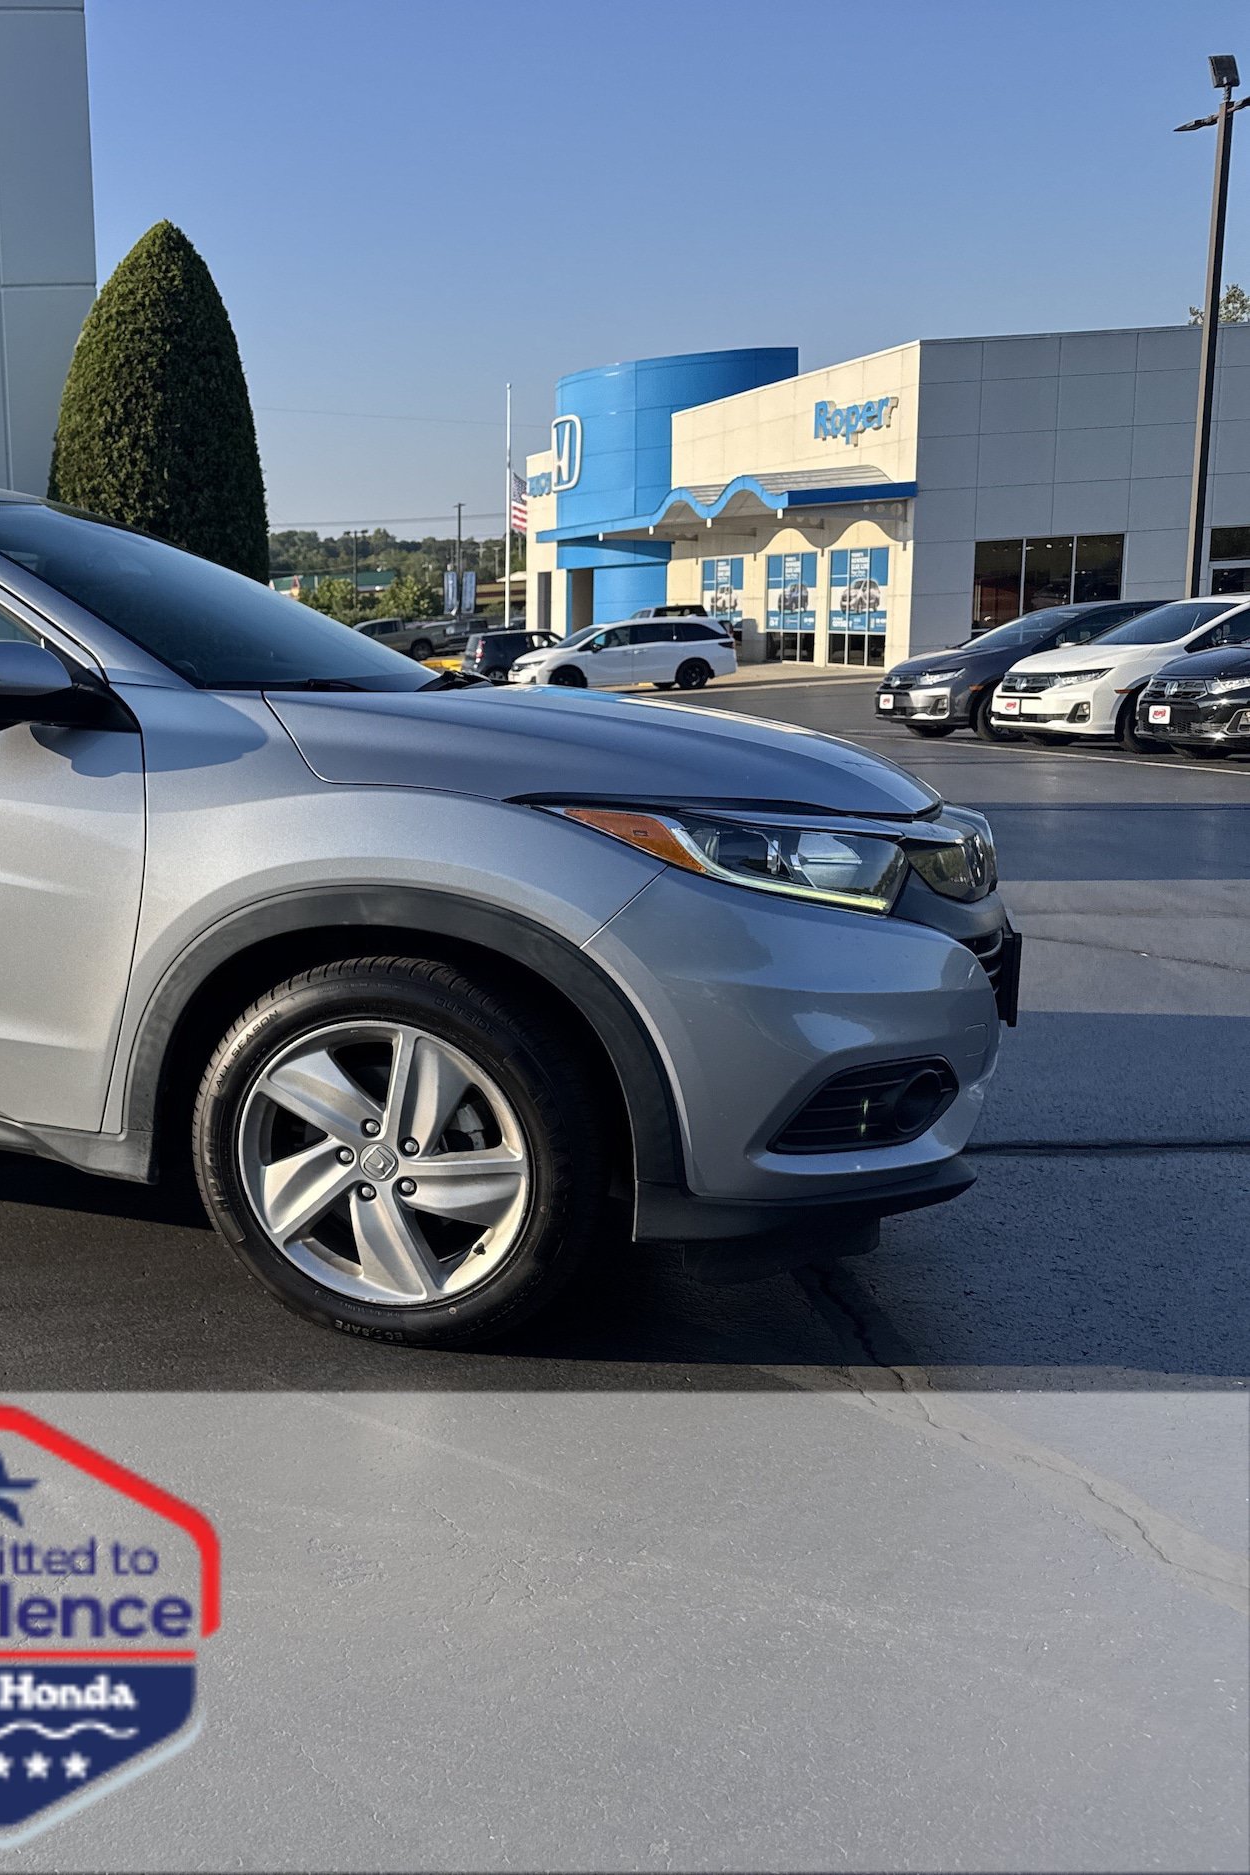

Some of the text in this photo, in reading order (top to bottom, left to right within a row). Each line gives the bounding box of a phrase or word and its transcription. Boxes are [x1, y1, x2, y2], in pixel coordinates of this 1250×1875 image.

[814, 397, 896, 446] Roper
[434, 996, 500, 1037] OUTSIDE
[216, 1064, 230, 1090] ALL
[231, 1009, 282, 1059] SEASON
